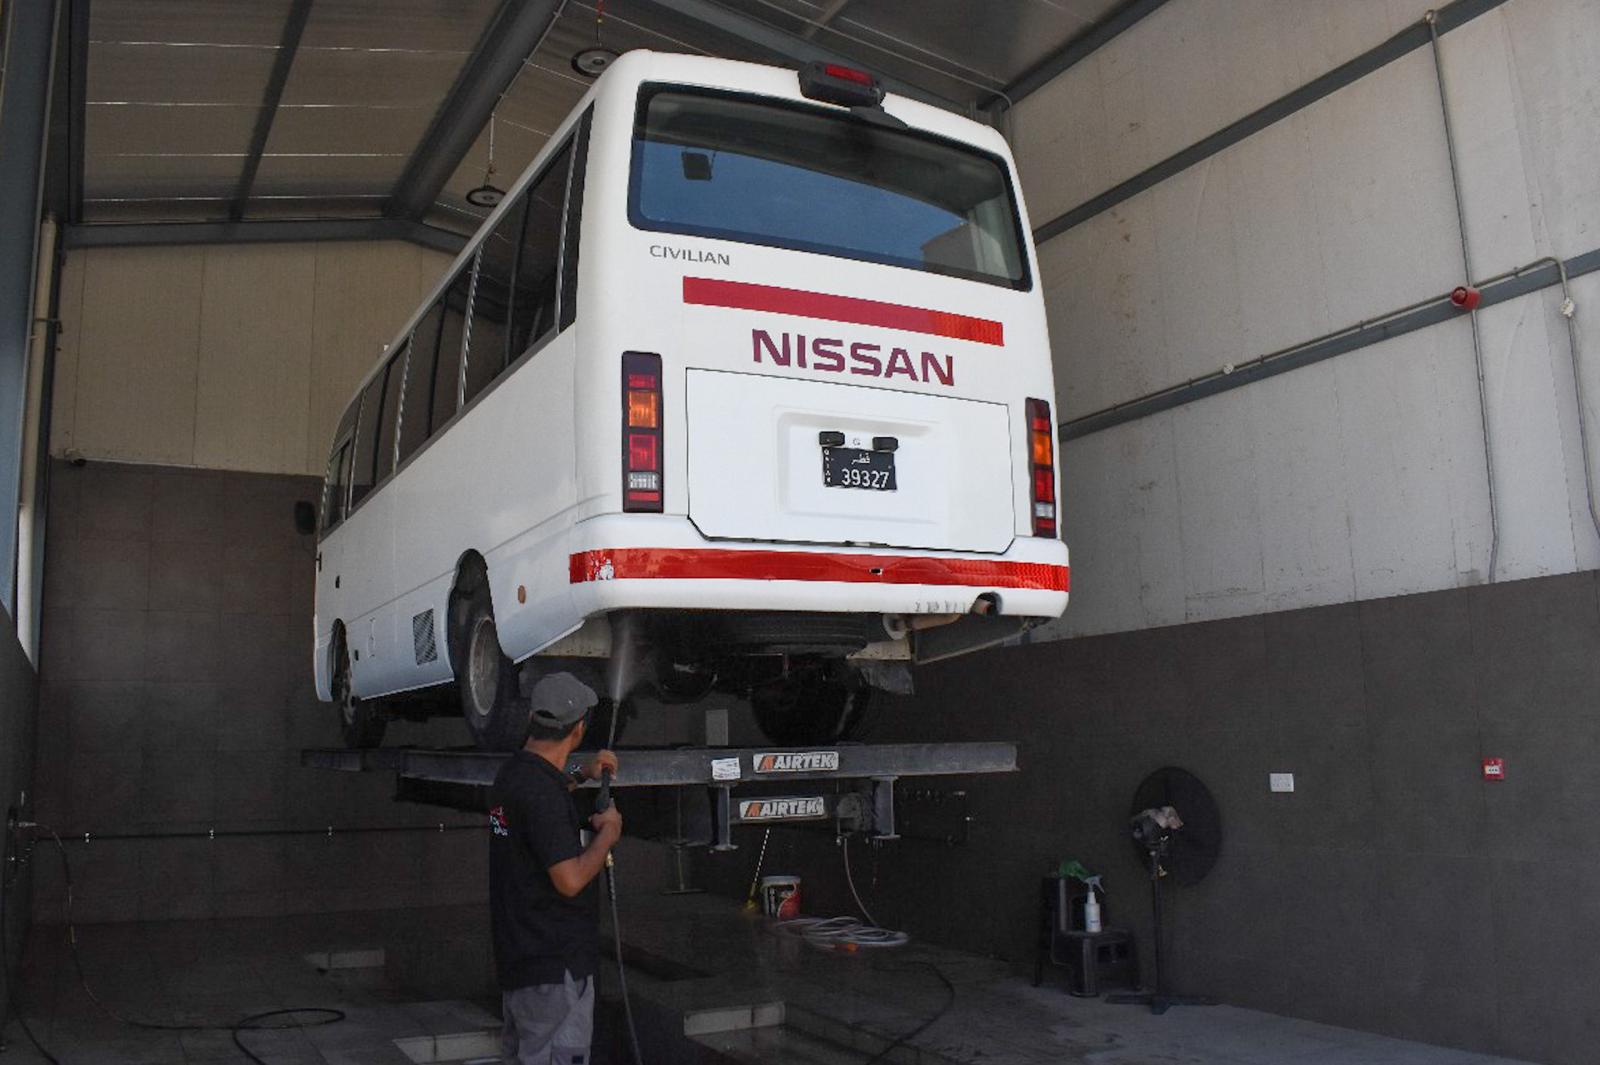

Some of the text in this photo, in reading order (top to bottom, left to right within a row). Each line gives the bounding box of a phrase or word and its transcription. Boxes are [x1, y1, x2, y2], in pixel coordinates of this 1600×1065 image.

[649, 245, 730, 265] CIVILIAN
[752, 328, 954, 386] NISSAN
[841, 468, 889, 488] 39327
[773, 754, 832, 769] AIRTEK
[761, 801, 817, 816] AIRTEK
